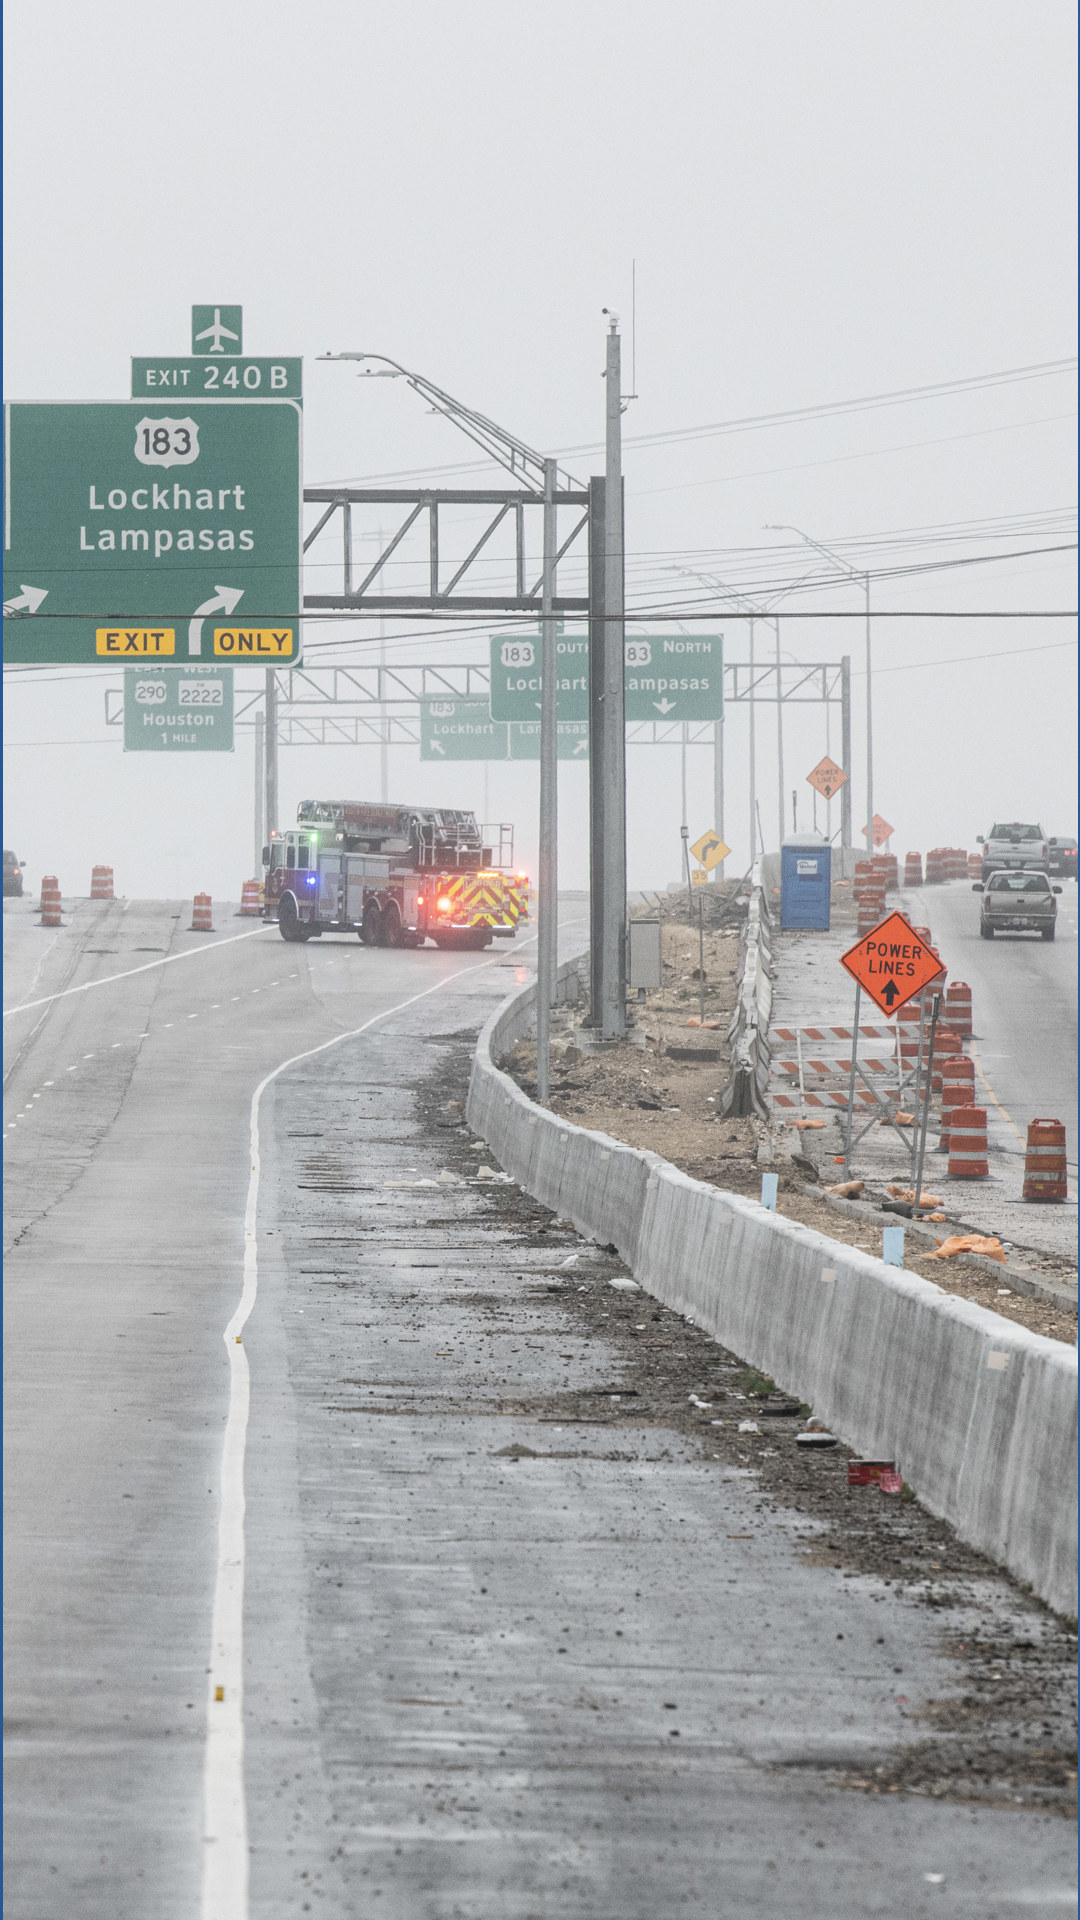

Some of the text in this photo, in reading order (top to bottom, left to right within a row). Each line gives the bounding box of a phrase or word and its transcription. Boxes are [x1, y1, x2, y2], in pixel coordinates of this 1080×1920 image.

[146, 365, 289, 390] EXIT 240 B
[142, 427, 192, 456] 183
[89, 483, 246, 511] Lockhart
[80, 526, 255, 558] Lampasas
[106, 633, 289, 651] EXIT ONLY
[663, 640, 711, 653] NORTH
[504, 647, 532, 661] 183
[627, 647, 648, 661] 83
[137, 686, 165, 699] 290
[625, 678, 710, 693] ampasas
[181, 689, 222, 704] 2222
[143, 713, 214, 726] Houston
[433, 723, 495, 735] Lockhart
[161, 732, 197, 744] 1 MILE
[866, 941, 922, 960] POWER
[868, 960, 915, 976] LINES
